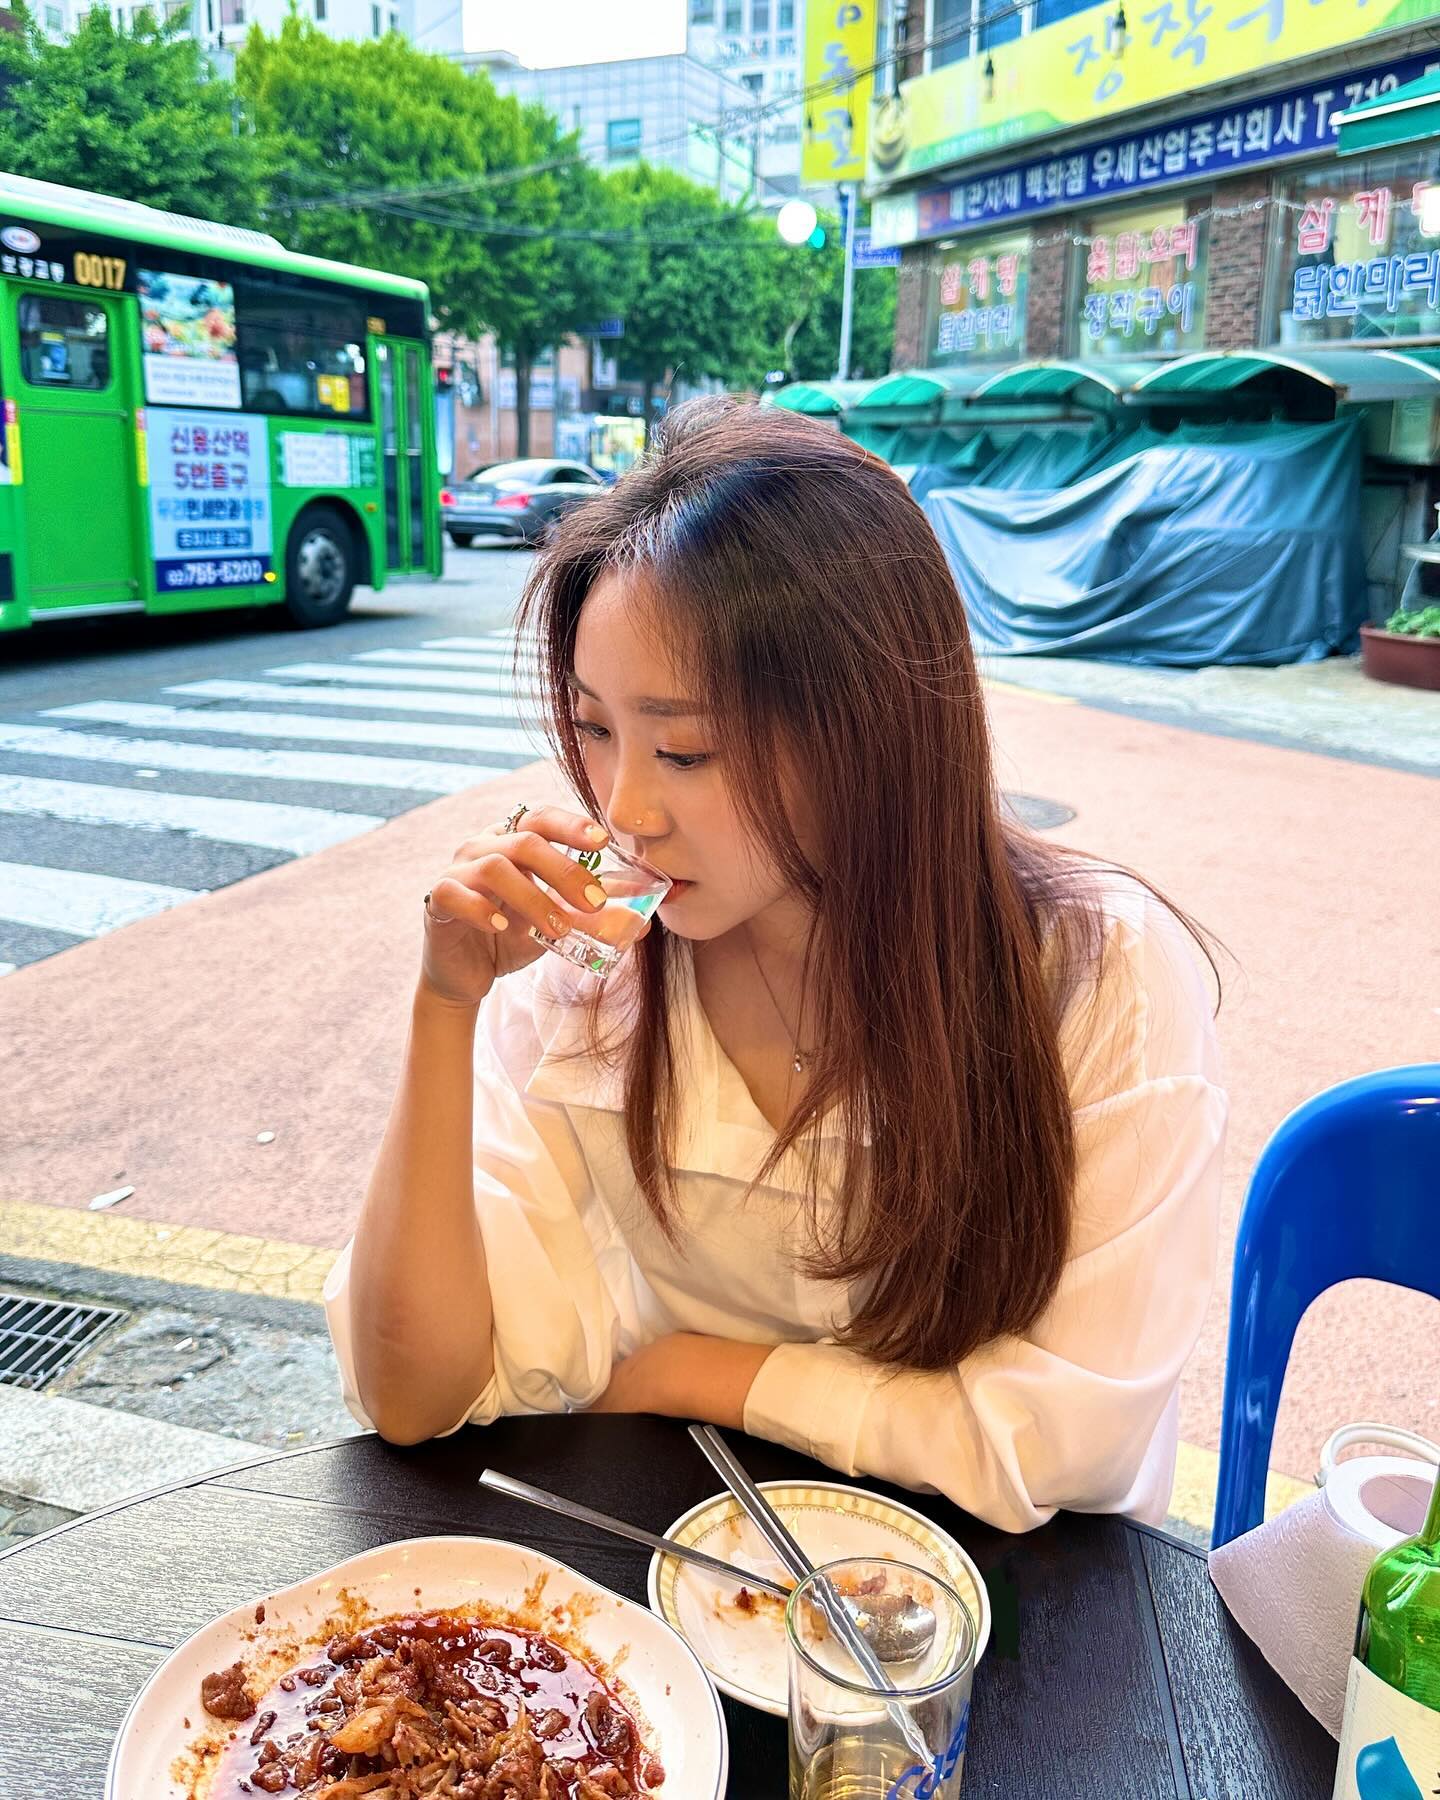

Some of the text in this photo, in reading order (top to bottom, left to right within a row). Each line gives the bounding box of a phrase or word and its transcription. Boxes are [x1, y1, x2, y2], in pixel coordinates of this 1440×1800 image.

[1026, 153, 1088, 203] 백화점
[1092, 98, 1307, 188] 우세산업주식회사
[1298, 184, 1440, 255] 삼계
[73, 251, 127, 290] 0017
[1293, 249, 1440, 321] 닭한마리
[173, 461, 249, 491] 5번출구
